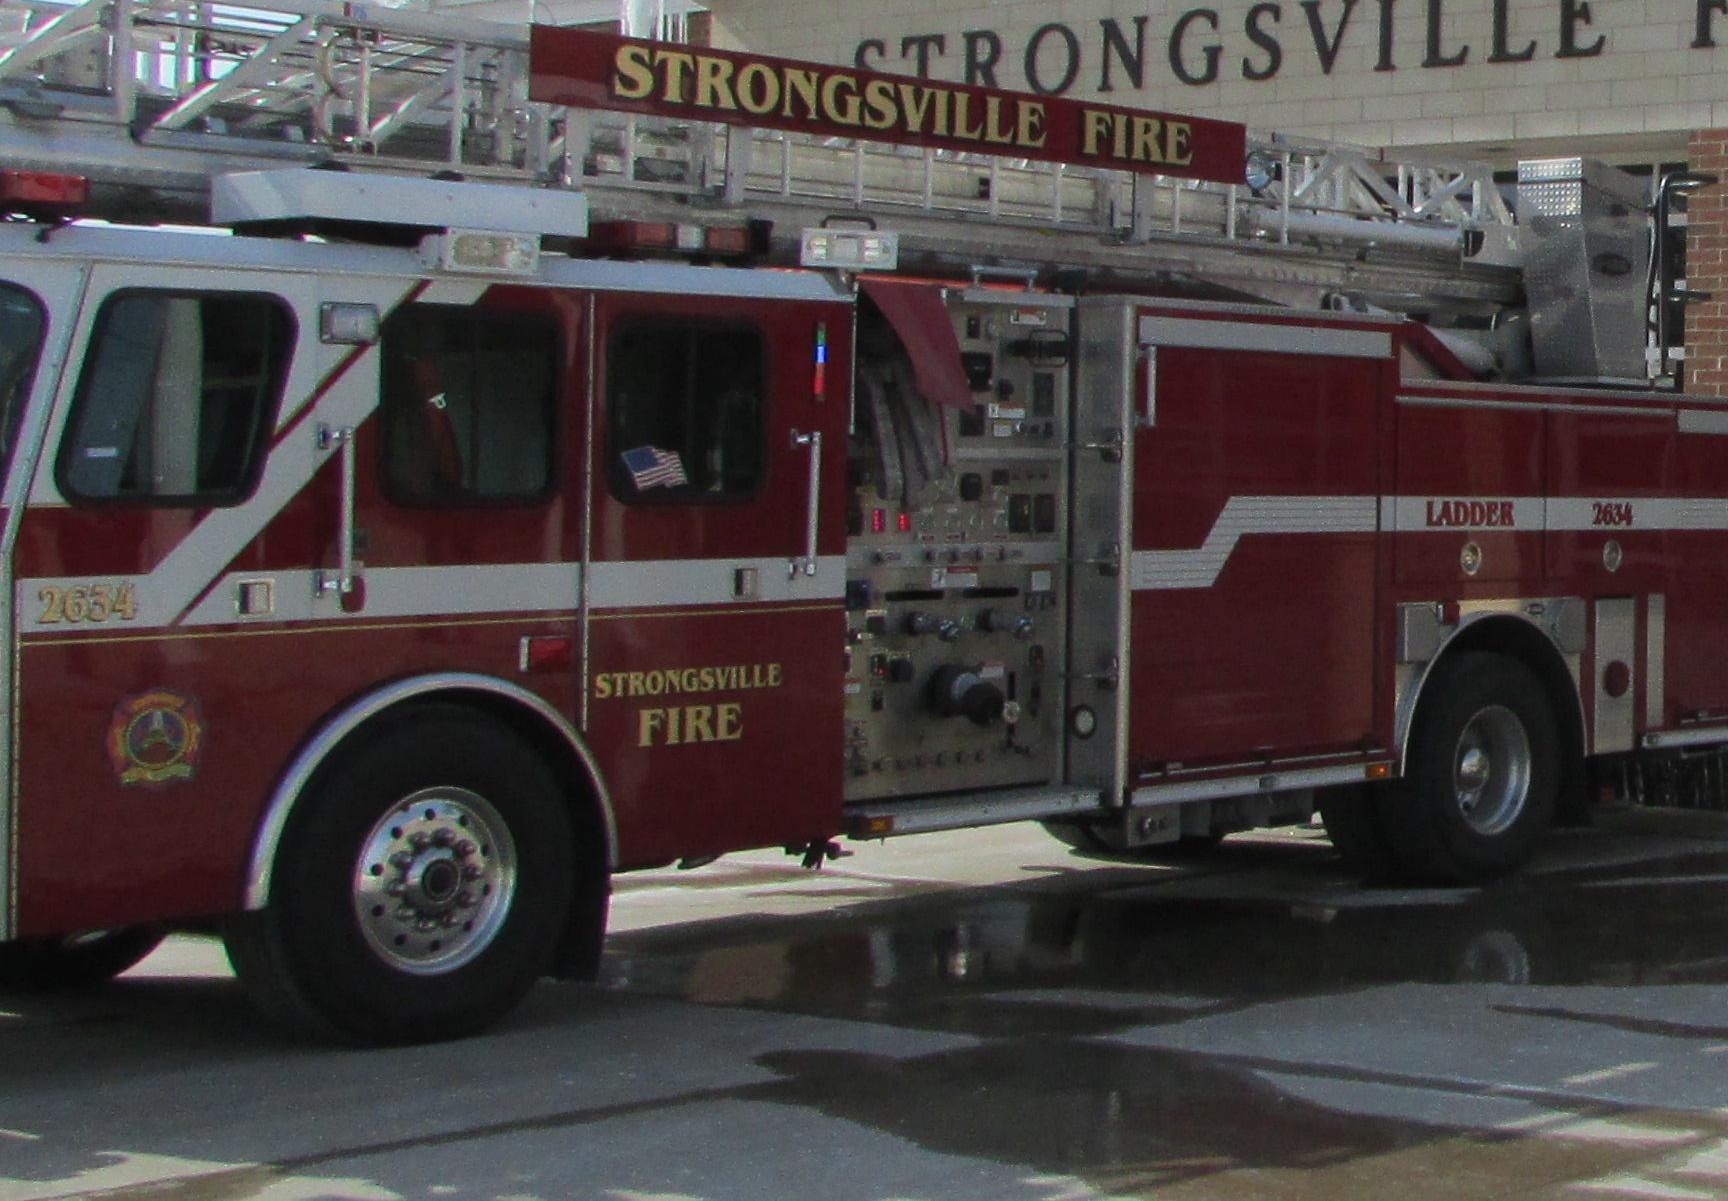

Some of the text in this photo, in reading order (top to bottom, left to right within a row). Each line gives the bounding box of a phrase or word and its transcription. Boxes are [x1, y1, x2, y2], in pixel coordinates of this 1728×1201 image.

[612, 44, 1195, 167] STRONGSVILLE FIRE
[1425, 500, 1634, 527] LADDER 2634
[37, 582, 136, 624] 2634
[595, 661, 782, 699] STRONGSVILLE
[638, 702, 744, 748] FIRE
